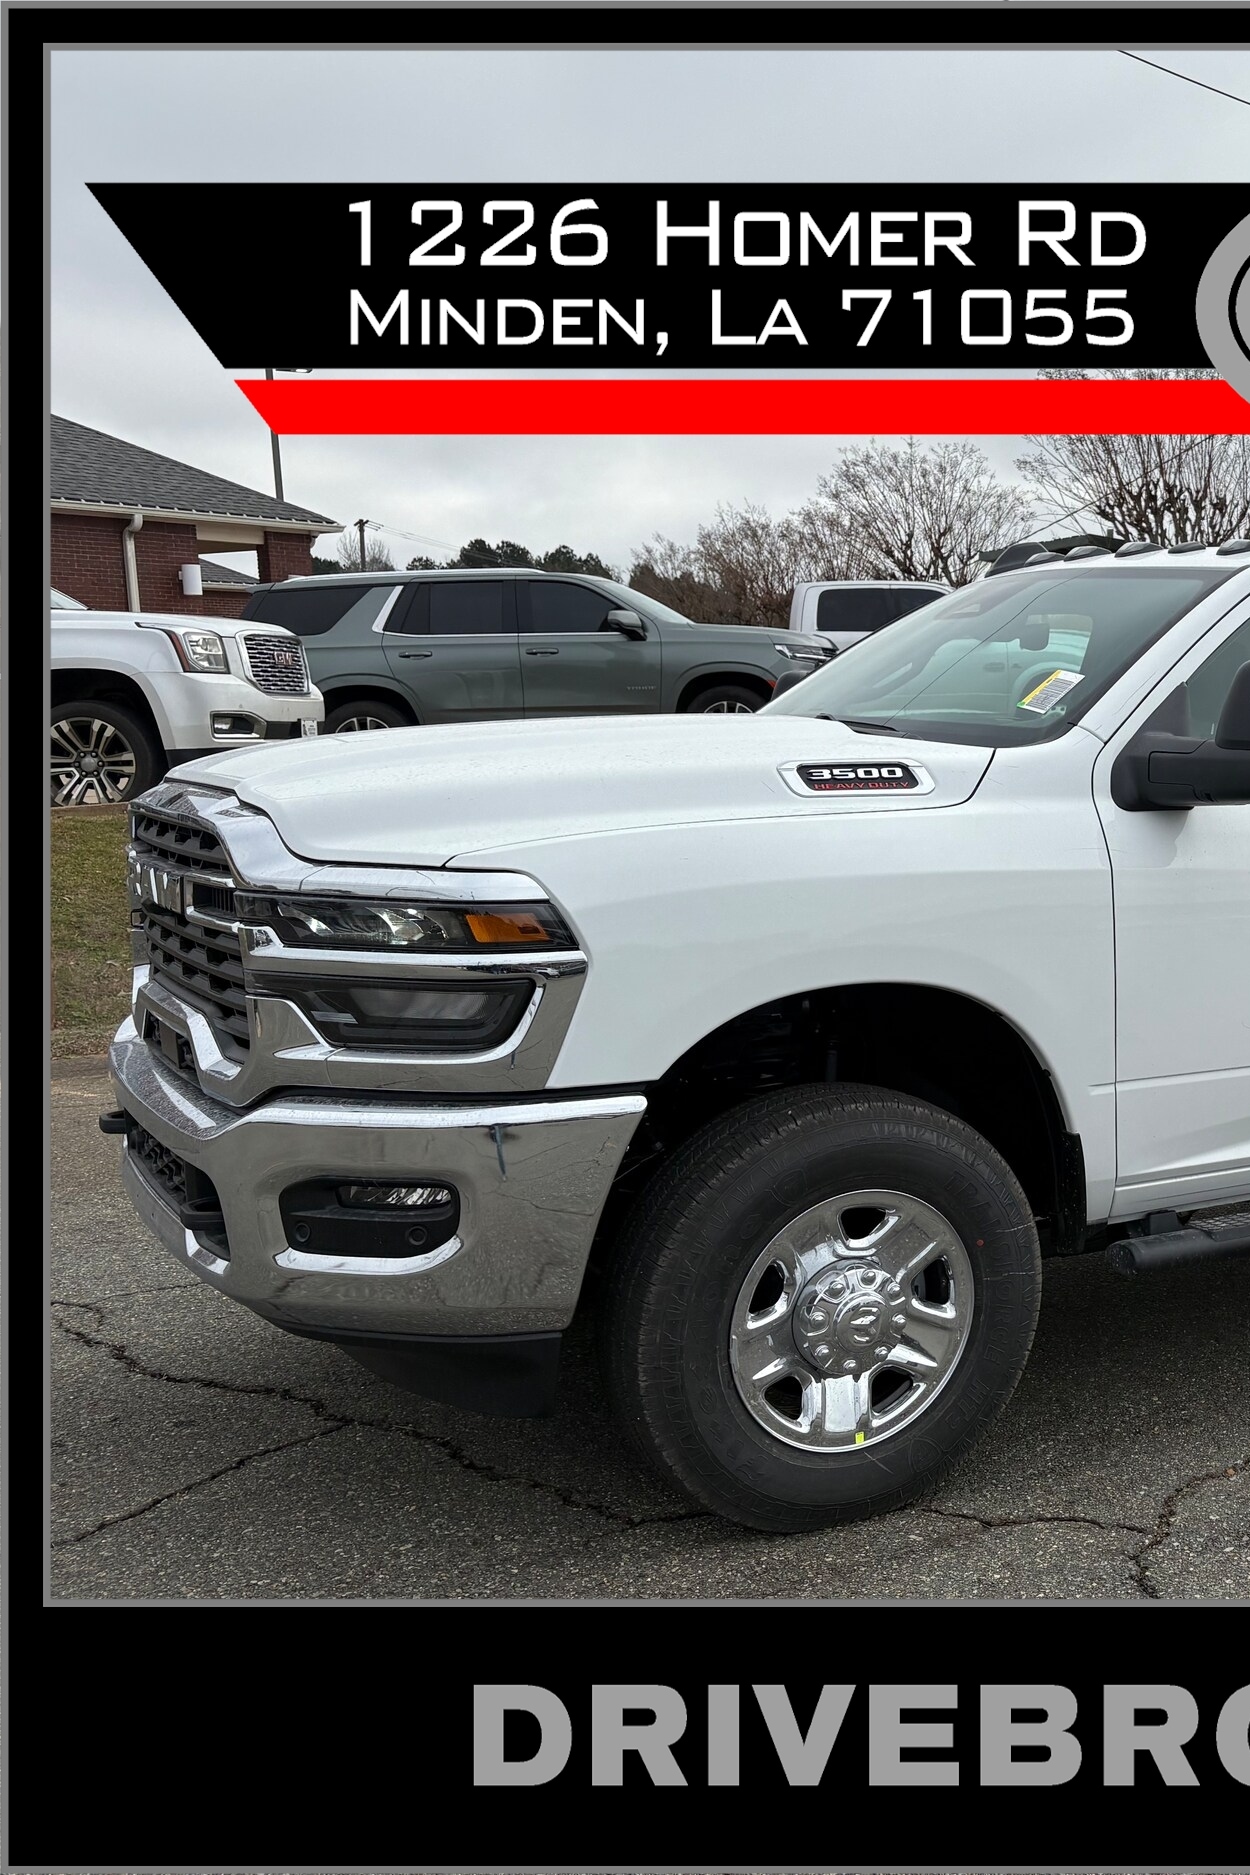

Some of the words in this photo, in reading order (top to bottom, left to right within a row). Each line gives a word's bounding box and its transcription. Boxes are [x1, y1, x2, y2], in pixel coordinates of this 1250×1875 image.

[807, 767, 904, 780] 3500
[814, 782, 865, 791] HEAVY
[868, 781, 909, 790] DUTY
